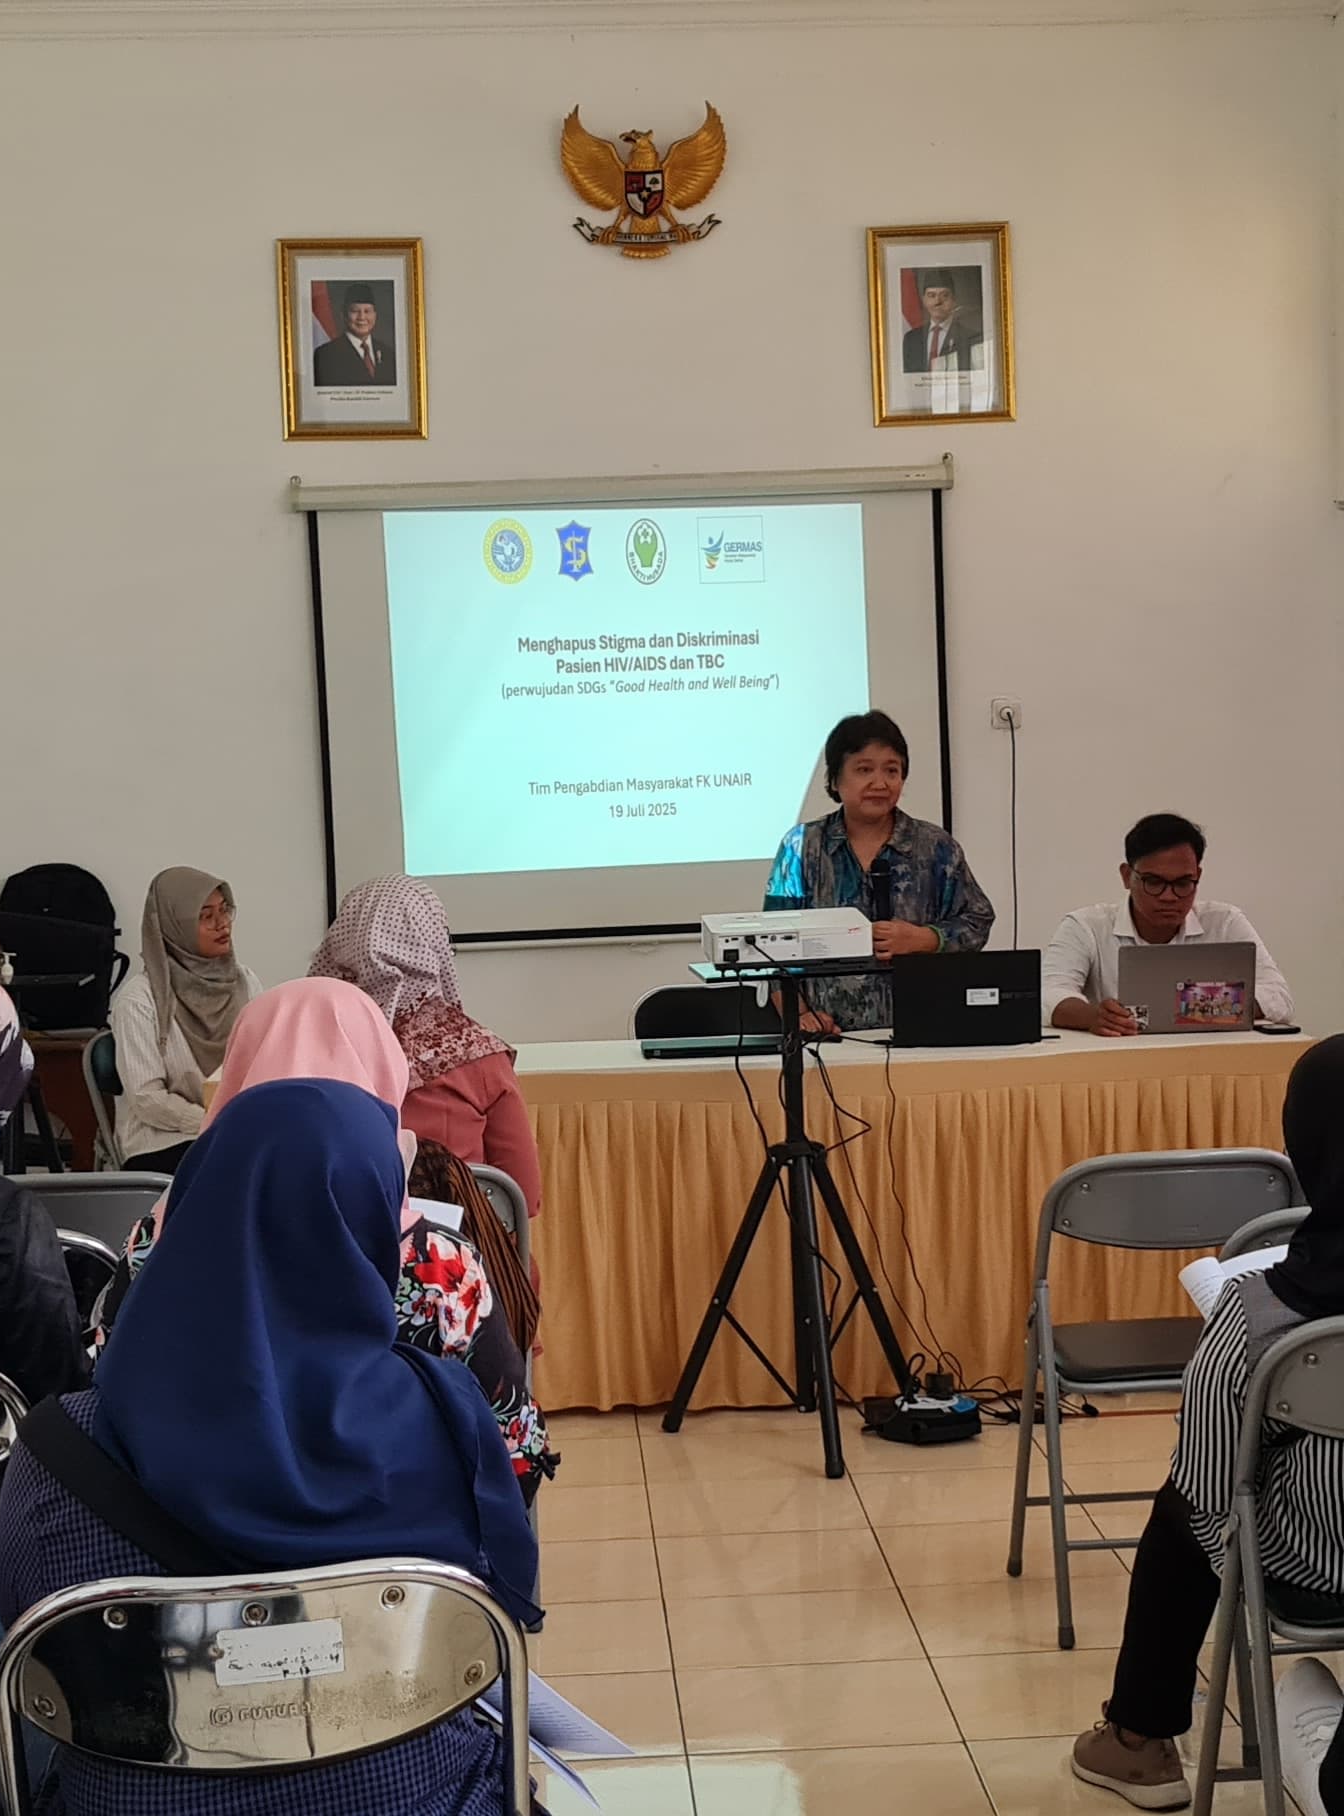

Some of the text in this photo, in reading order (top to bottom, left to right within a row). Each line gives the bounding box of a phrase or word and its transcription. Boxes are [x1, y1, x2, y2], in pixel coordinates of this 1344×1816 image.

[724, 541, 763, 552] GERMAS
[517, 629, 760, 655] Menghapus Stigma dan Diskriminasi
[556, 653, 725, 674] Pasien HIV/AIDS dan TBC
[502, 682, 574, 700] (perwujudan
[577, 681, 607, 694] SDGs
[649, 678, 684, 692] Health
[688, 676, 709, 690] and
[712, 676, 736, 689] Well
[528, 772, 752, 796] Tim Pengabdian Masyarakat FK UNAIR
[609, 802, 677, 818] 19 Juli 2025
